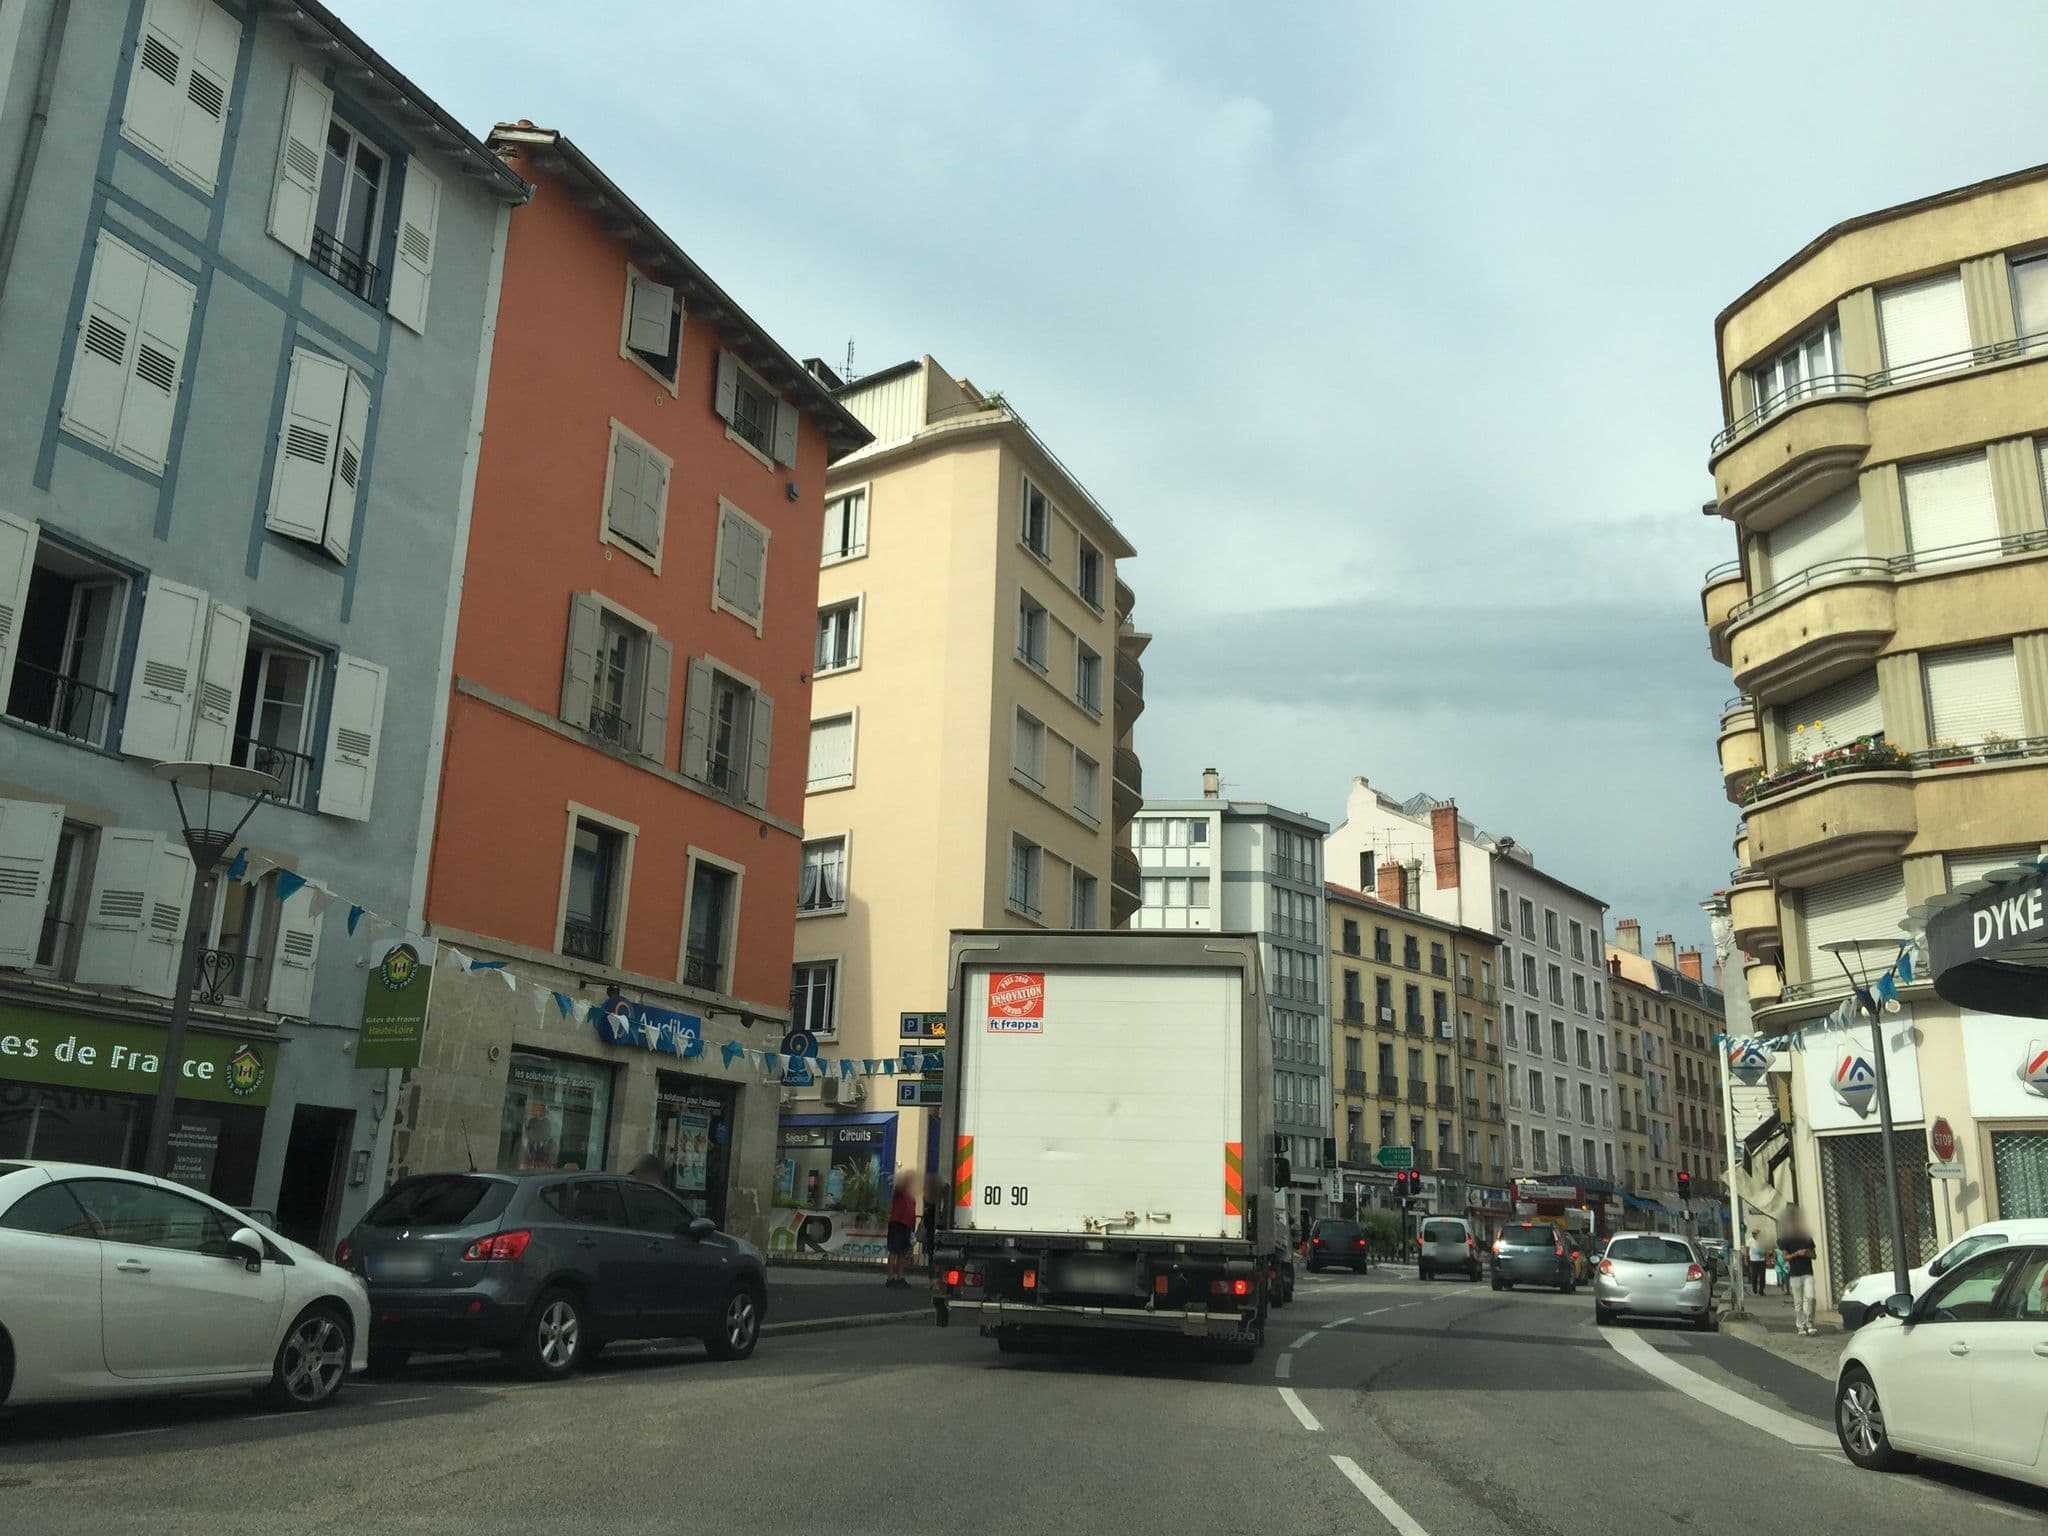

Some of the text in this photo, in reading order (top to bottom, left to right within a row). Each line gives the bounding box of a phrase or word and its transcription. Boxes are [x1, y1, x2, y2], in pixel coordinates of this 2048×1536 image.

[1973, 888, 2044, 948] DYKE
[992, 985, 1042, 1005] INNOVATION
[369, 1024, 415, 1035] Haute-Loire
[1001, 1020, 1039, 1030] frappa
[54, 1036, 97, 1065] de
[110, 1045, 215, 1079] Frace
[839, 1129, 871, 1142] Circuits
[1934, 1133, 1952, 1147] STOP
[984, 1185, 1028, 1206] 80 90
